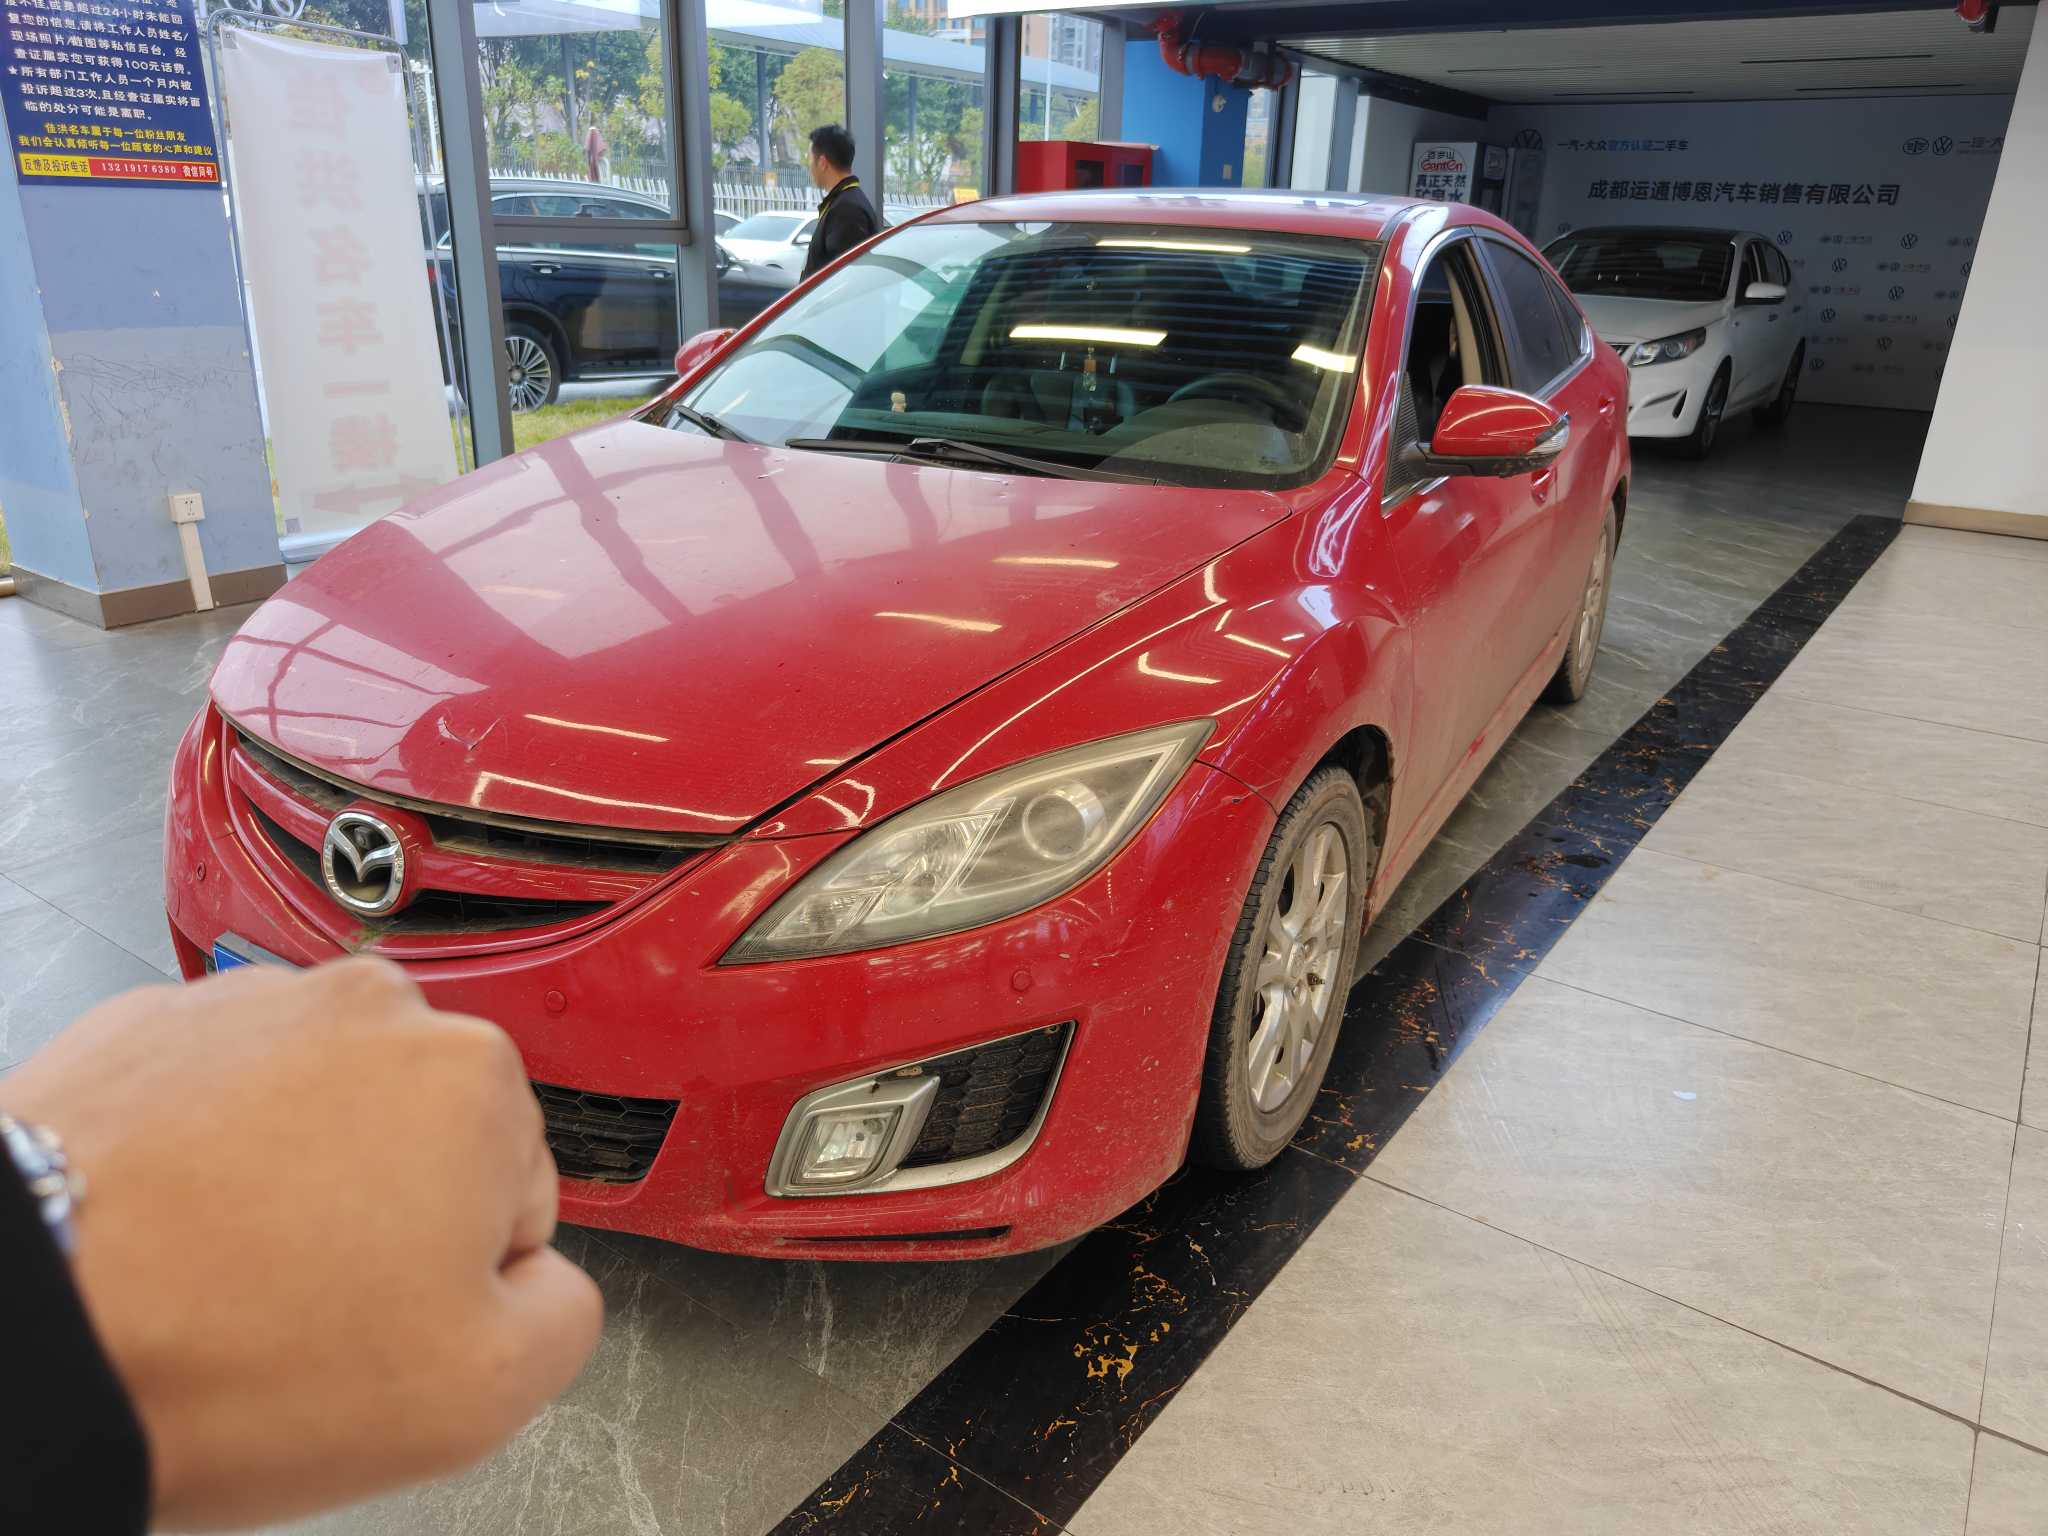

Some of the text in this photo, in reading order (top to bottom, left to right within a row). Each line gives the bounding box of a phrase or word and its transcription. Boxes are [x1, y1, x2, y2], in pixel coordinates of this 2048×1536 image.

[20, 66, 193, 91] 所有部门工作人员一个月内被
[1415, 174, 1466, 188] 真正天然
[1587, 179, 1900, 206] 成都运通博恩汽车销售有限公司
